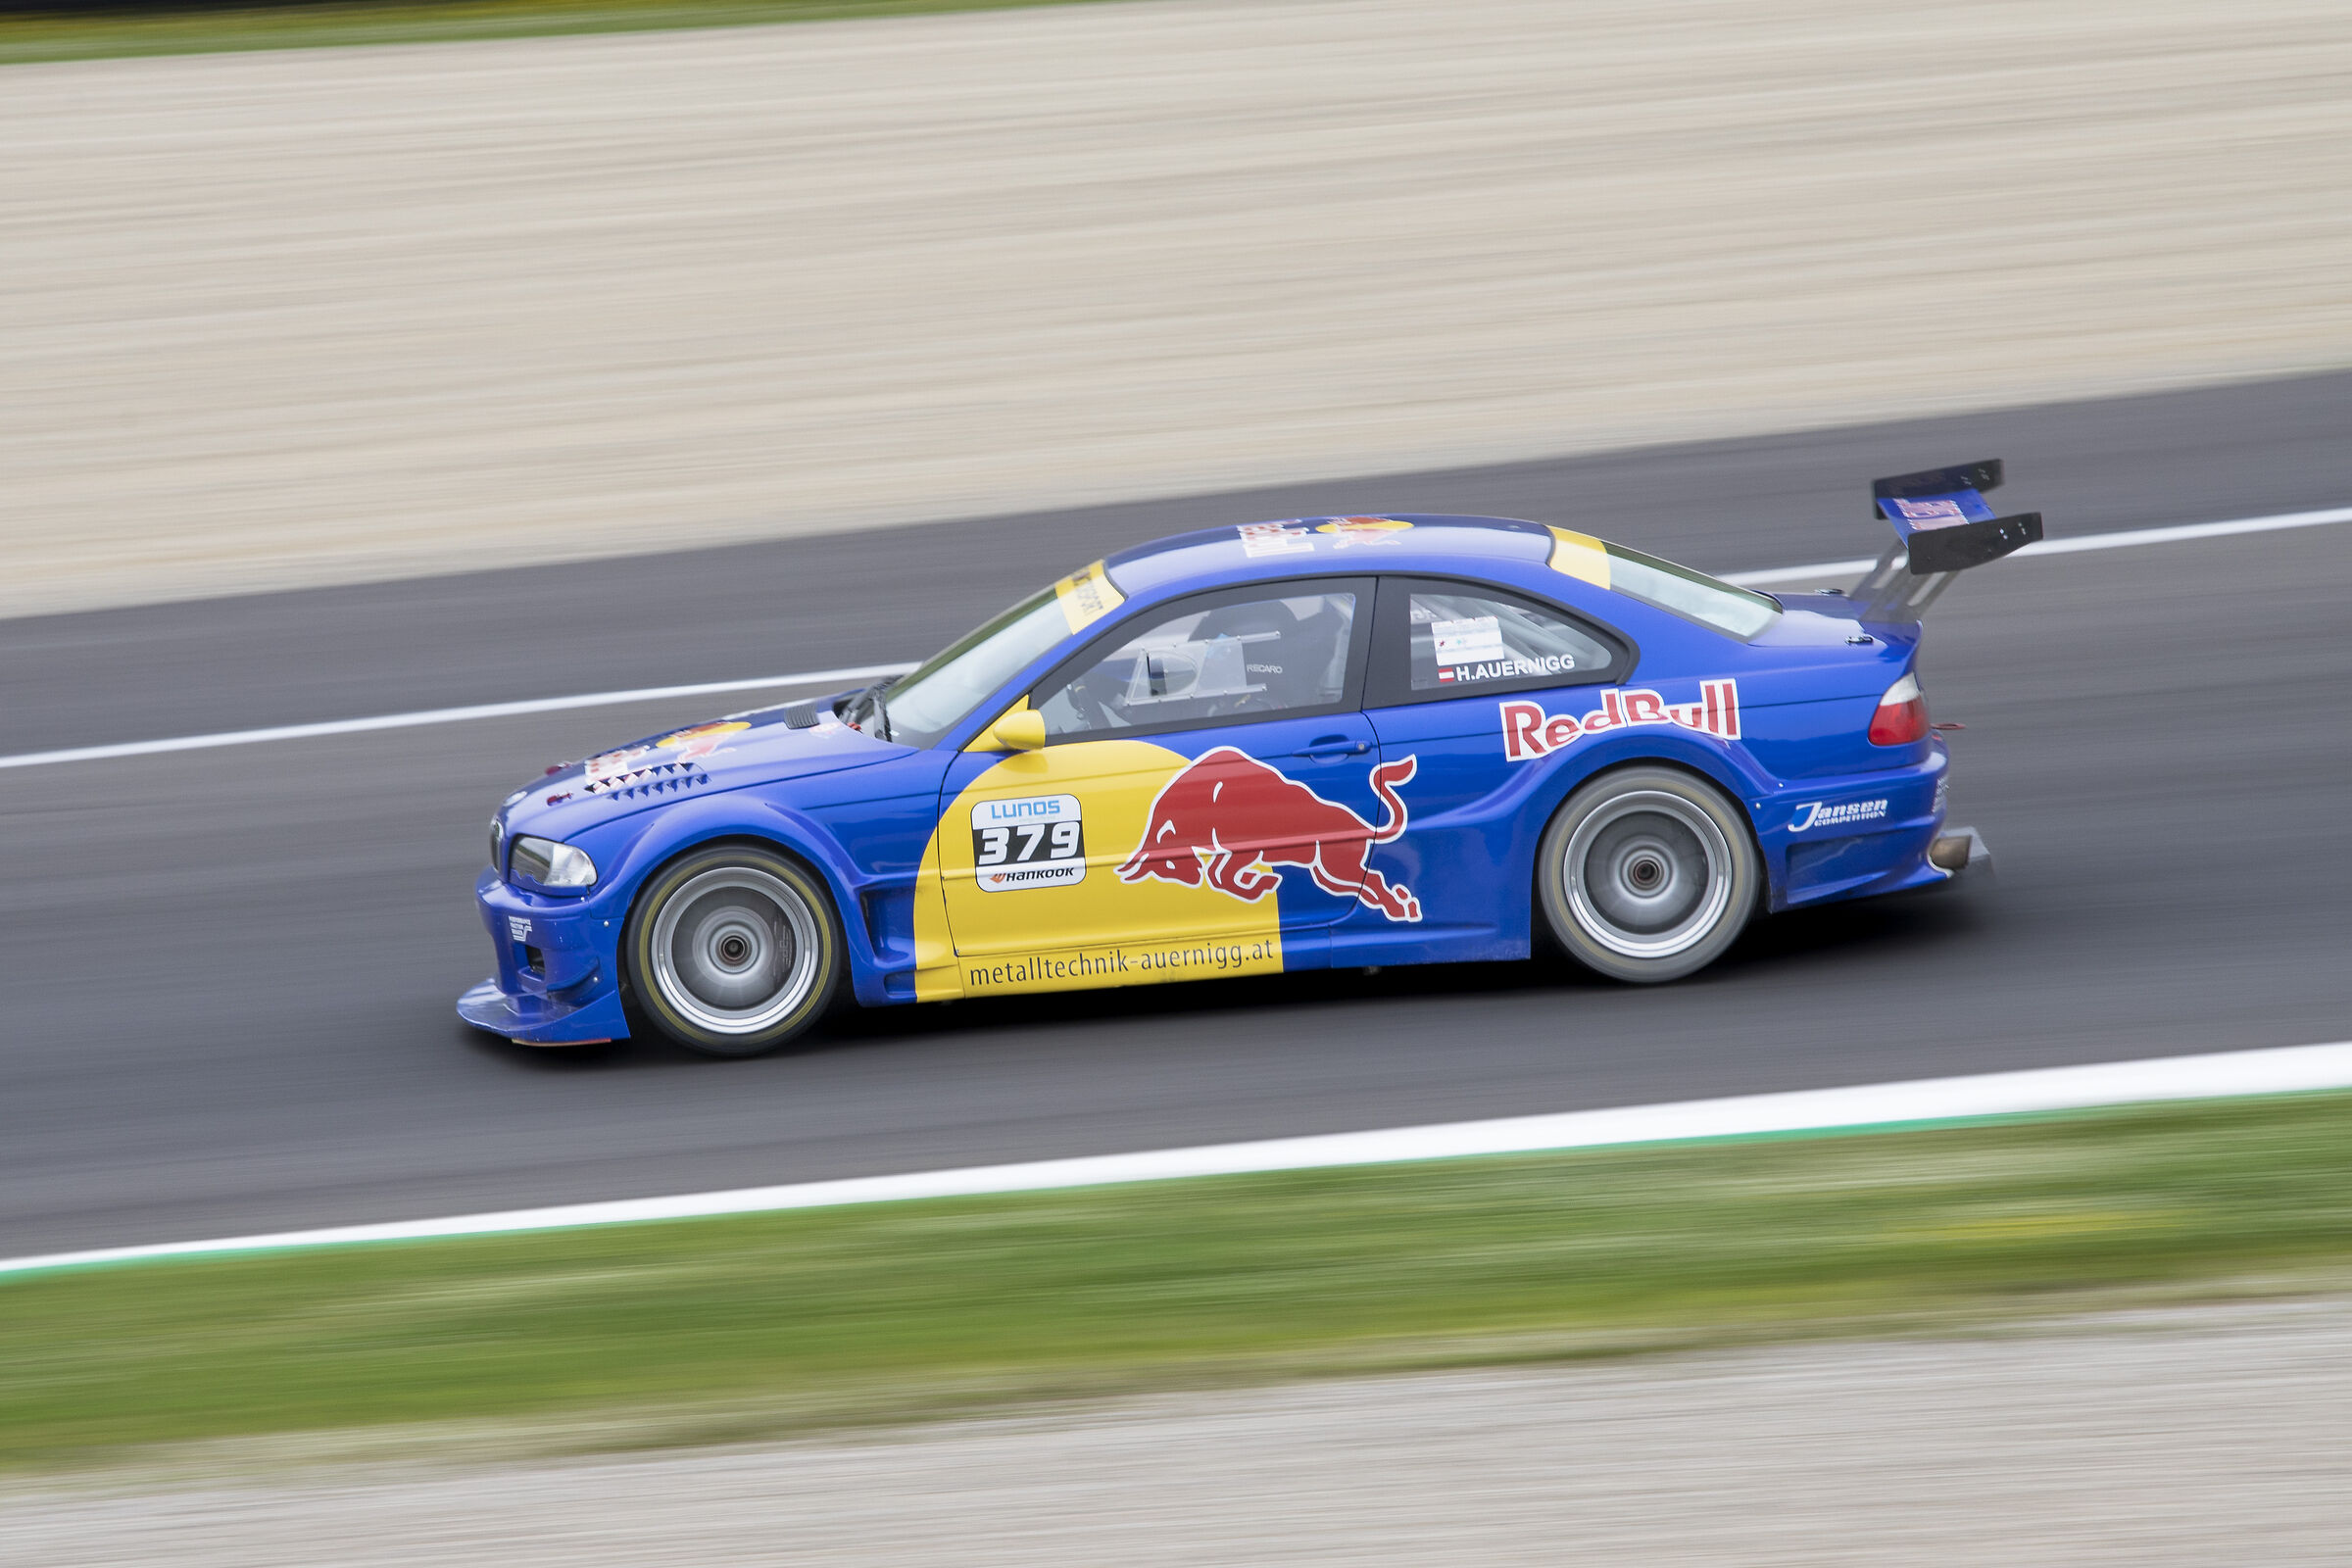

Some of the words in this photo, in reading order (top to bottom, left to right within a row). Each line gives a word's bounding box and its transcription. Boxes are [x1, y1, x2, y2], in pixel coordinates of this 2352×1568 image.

[1246, 663, 1283, 674] RECARO
[1455, 654, 1576, 682] H.AUERNIGG
[1788, 799, 1888, 832] Jansen
[978, 821, 1081, 865] 379
[969, 939, 1274, 986] metalltechnik-auernigg.at
